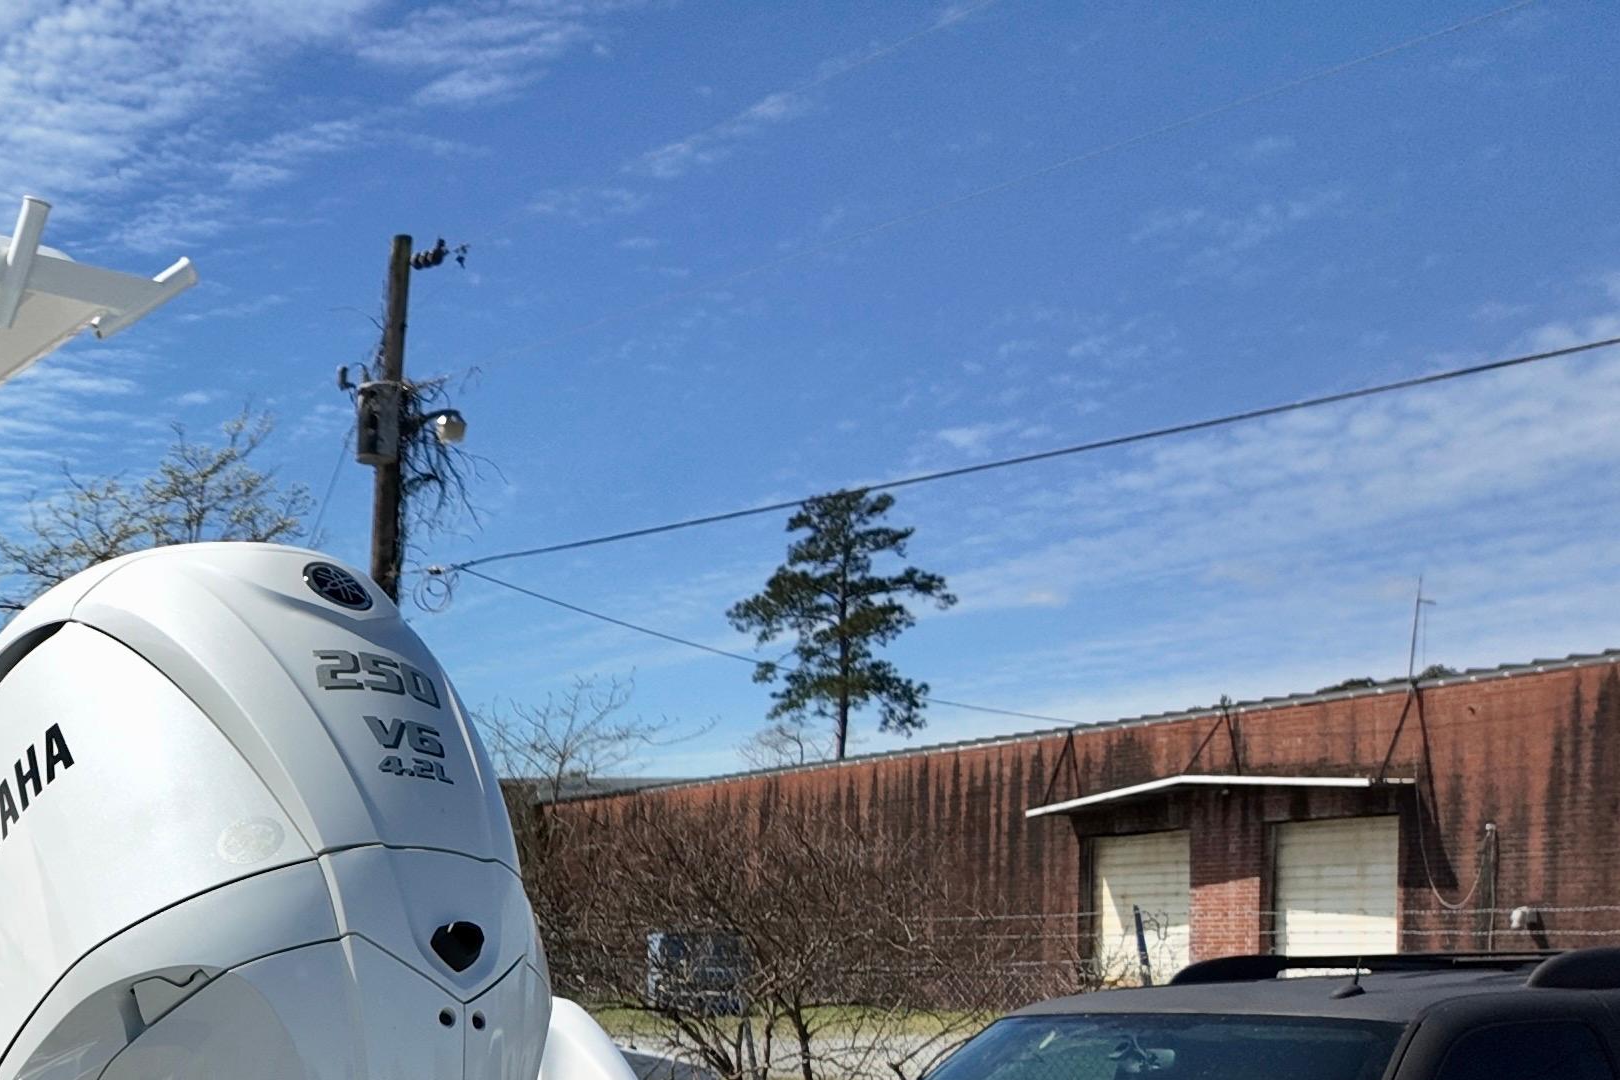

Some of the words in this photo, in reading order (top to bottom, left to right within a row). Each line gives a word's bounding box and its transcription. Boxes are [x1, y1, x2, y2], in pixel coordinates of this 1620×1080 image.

[312, 649, 441, 709] 250
[363, 715, 446, 759] V6
[378, 755, 455, 786] 4.2L
